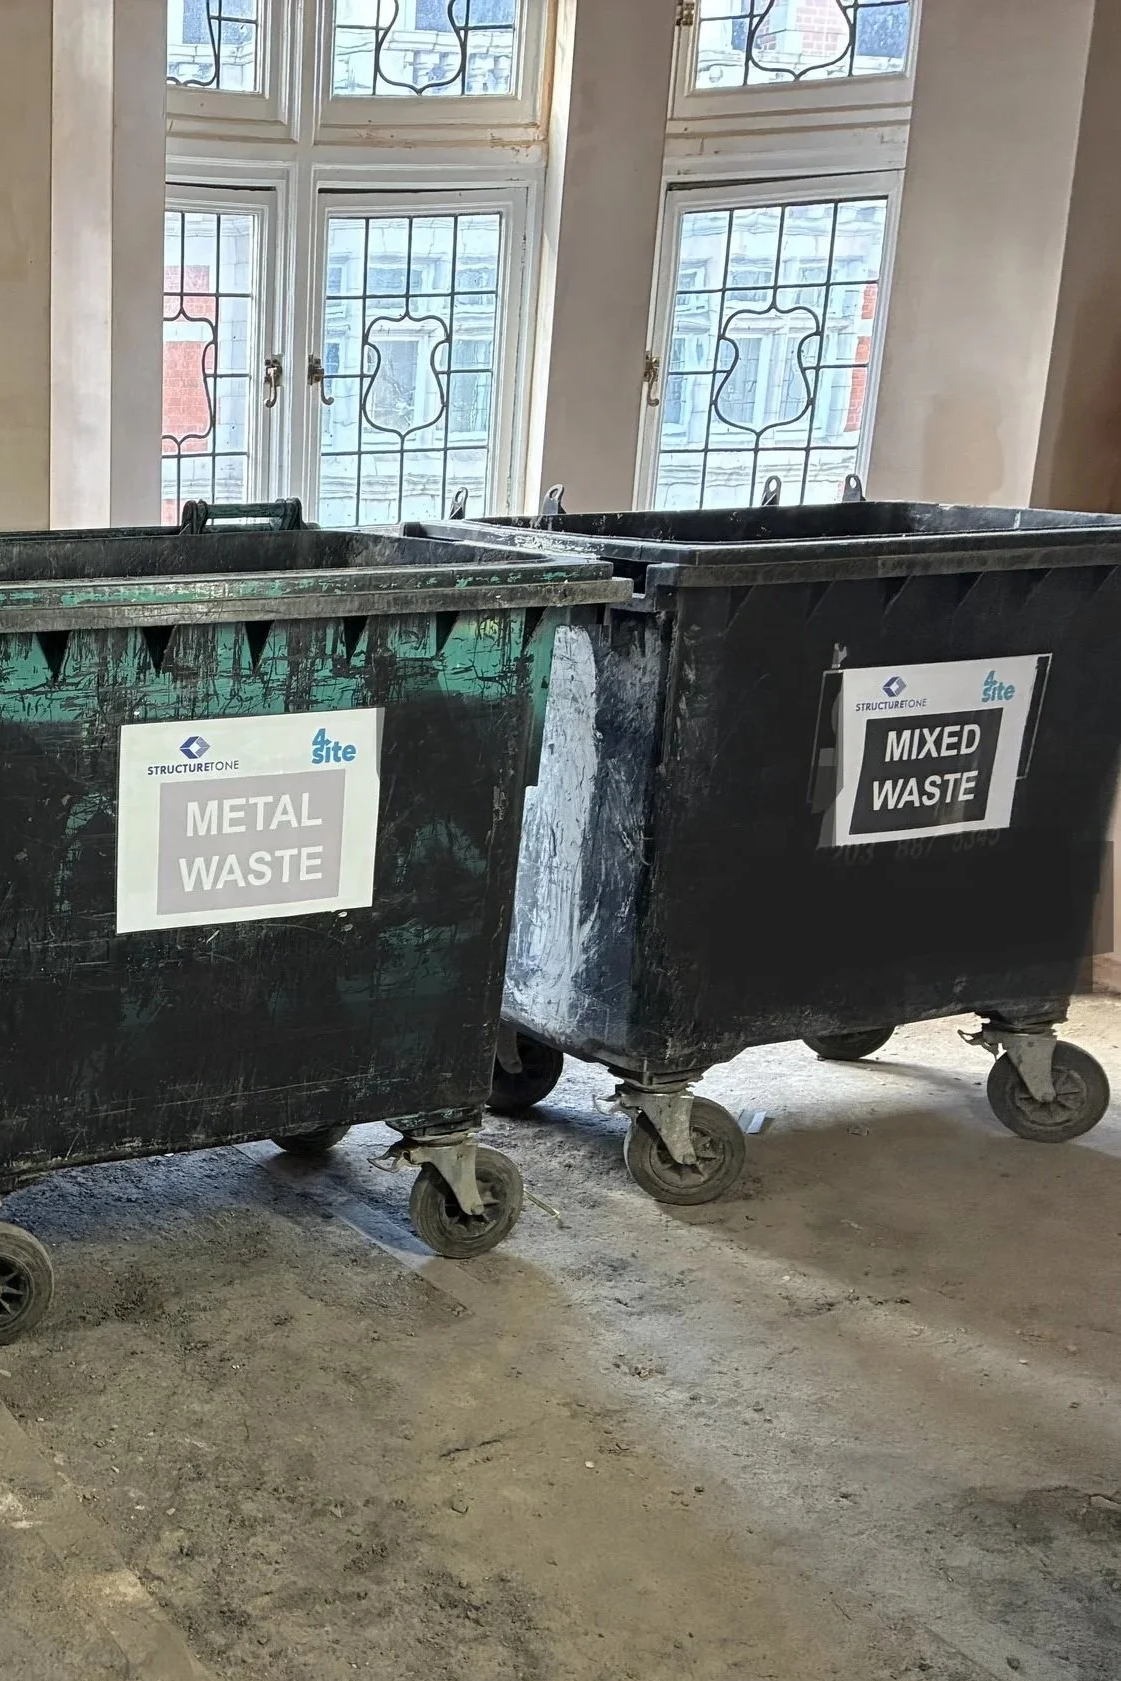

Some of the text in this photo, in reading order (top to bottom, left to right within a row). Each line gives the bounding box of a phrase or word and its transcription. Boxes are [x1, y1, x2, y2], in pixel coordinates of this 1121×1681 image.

[855, 698, 927, 712] STRUCTURETONE
[884, 723, 981, 762] MIXED
[147, 760, 240, 776] STRUCTURETONE
[872, 770, 979, 811] WASTE
[186, 792, 322, 837] METAL
[178, 845, 323, 892] WASTE
